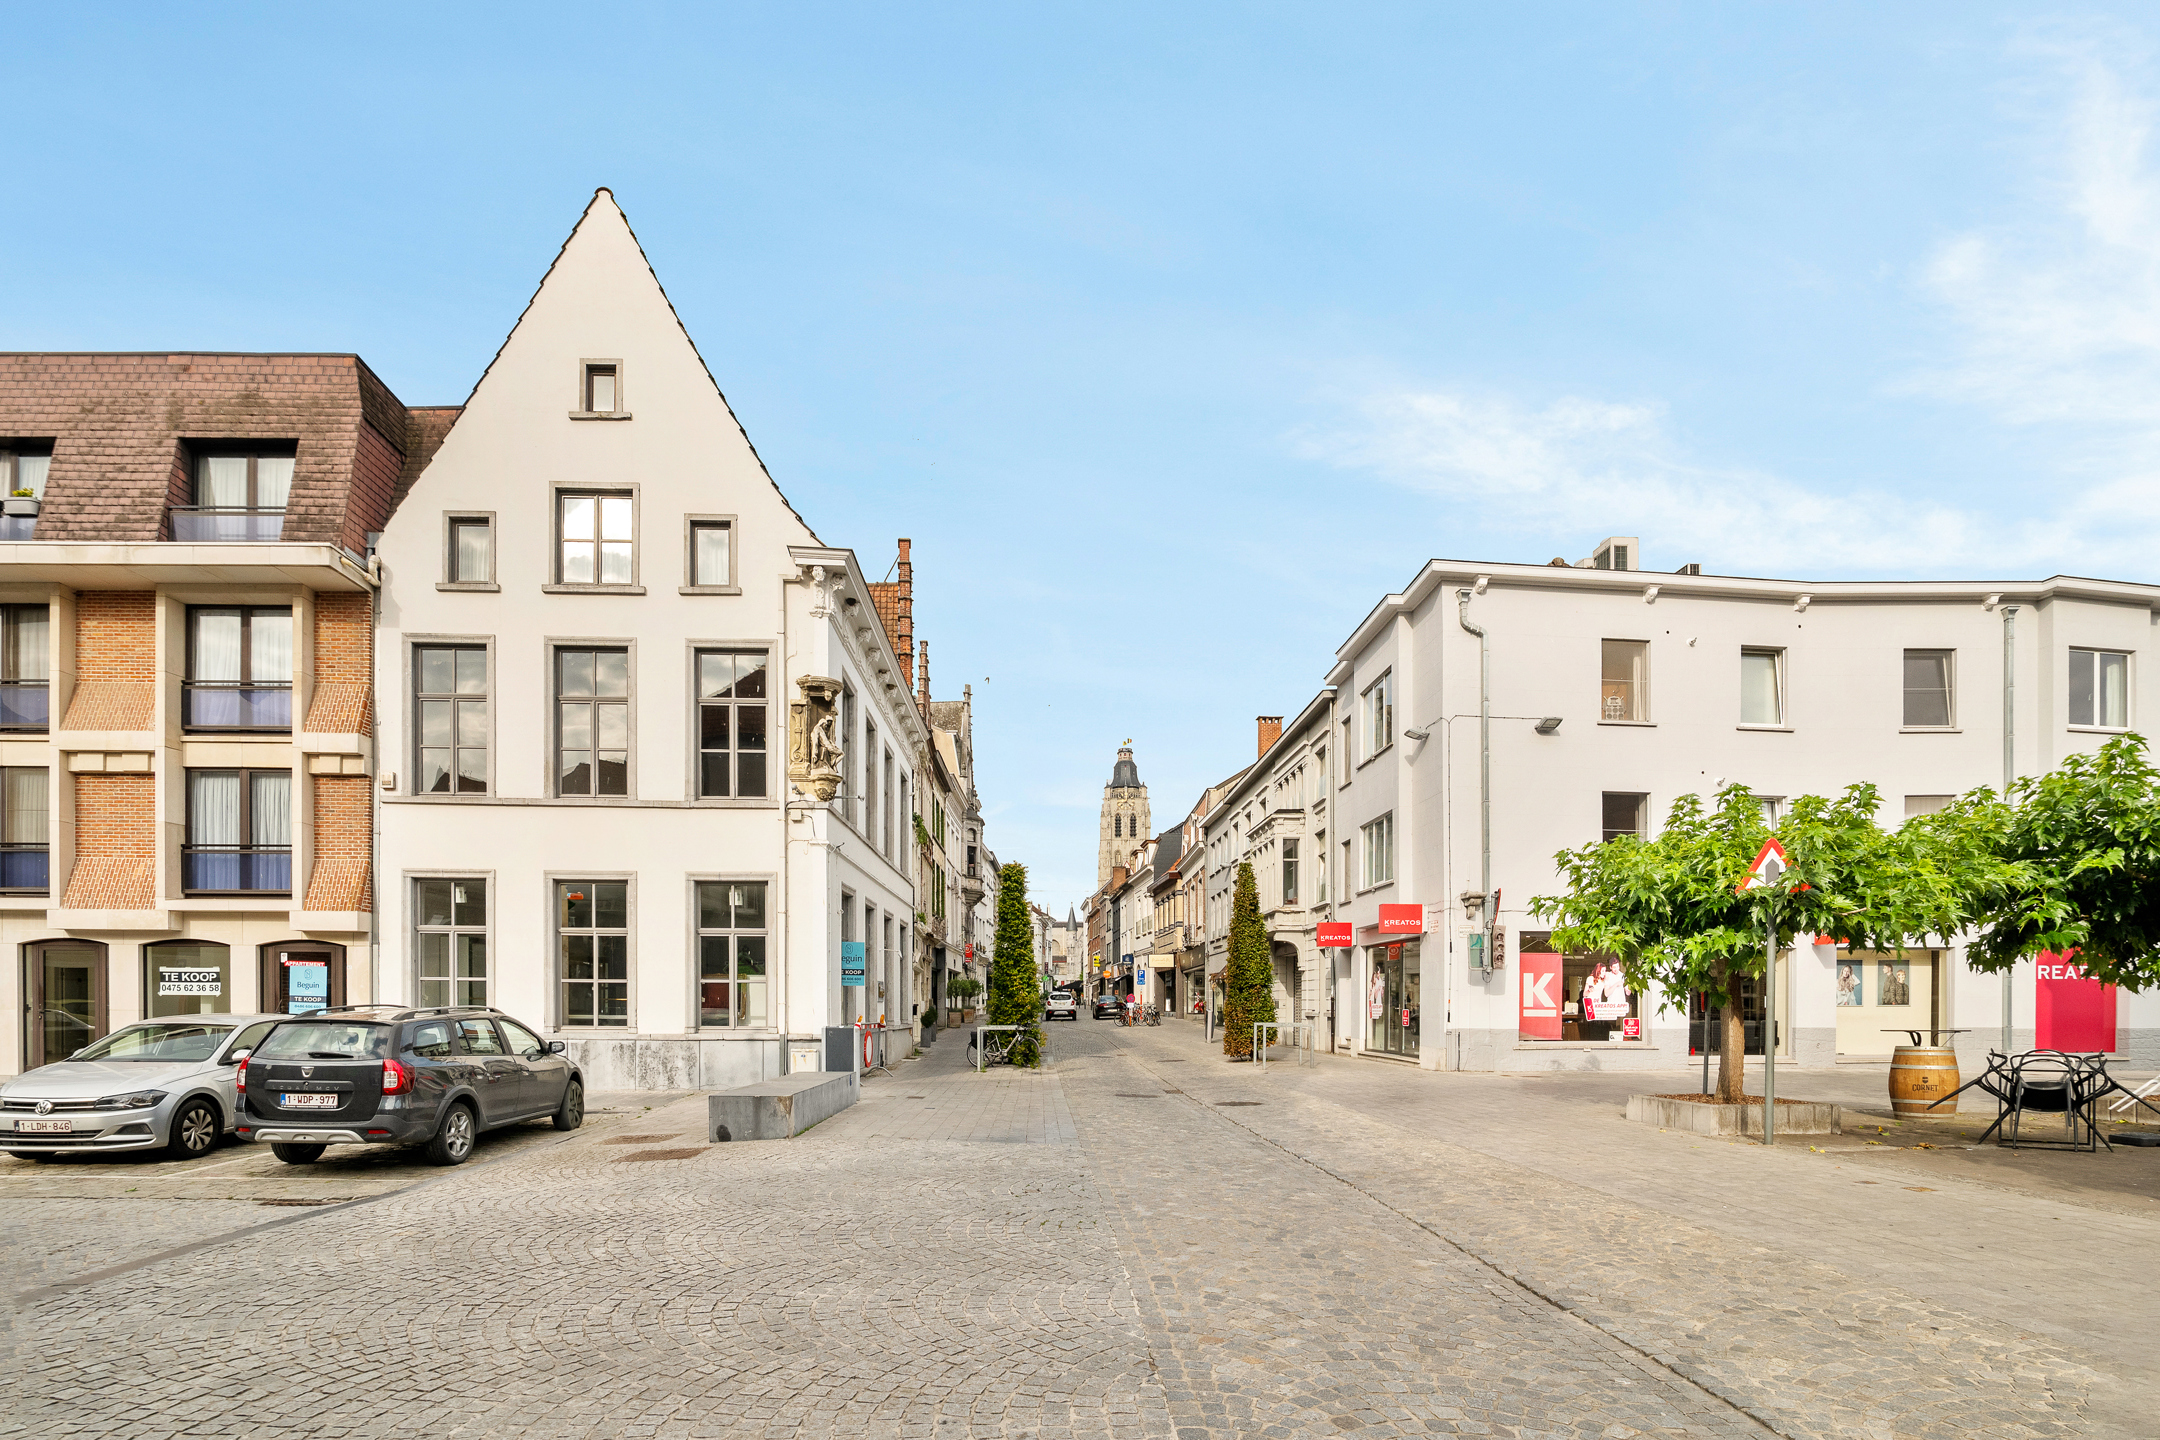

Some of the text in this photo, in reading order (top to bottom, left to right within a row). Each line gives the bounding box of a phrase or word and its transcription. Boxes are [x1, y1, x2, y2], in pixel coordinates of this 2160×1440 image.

[1384, 919, 1421, 927] KREATOS
[842, 955, 862, 964] eguin
[163, 972, 217, 982] TE KOOP
[2037, 965, 2100, 980] REAT
[161, 984, 220, 992] 0475 62 36 58
[297, 982, 319, 990] Beguin
[1523, 972, 1557, 1008] K
[21, 1122, 70, 1131] 1-LDH-846
